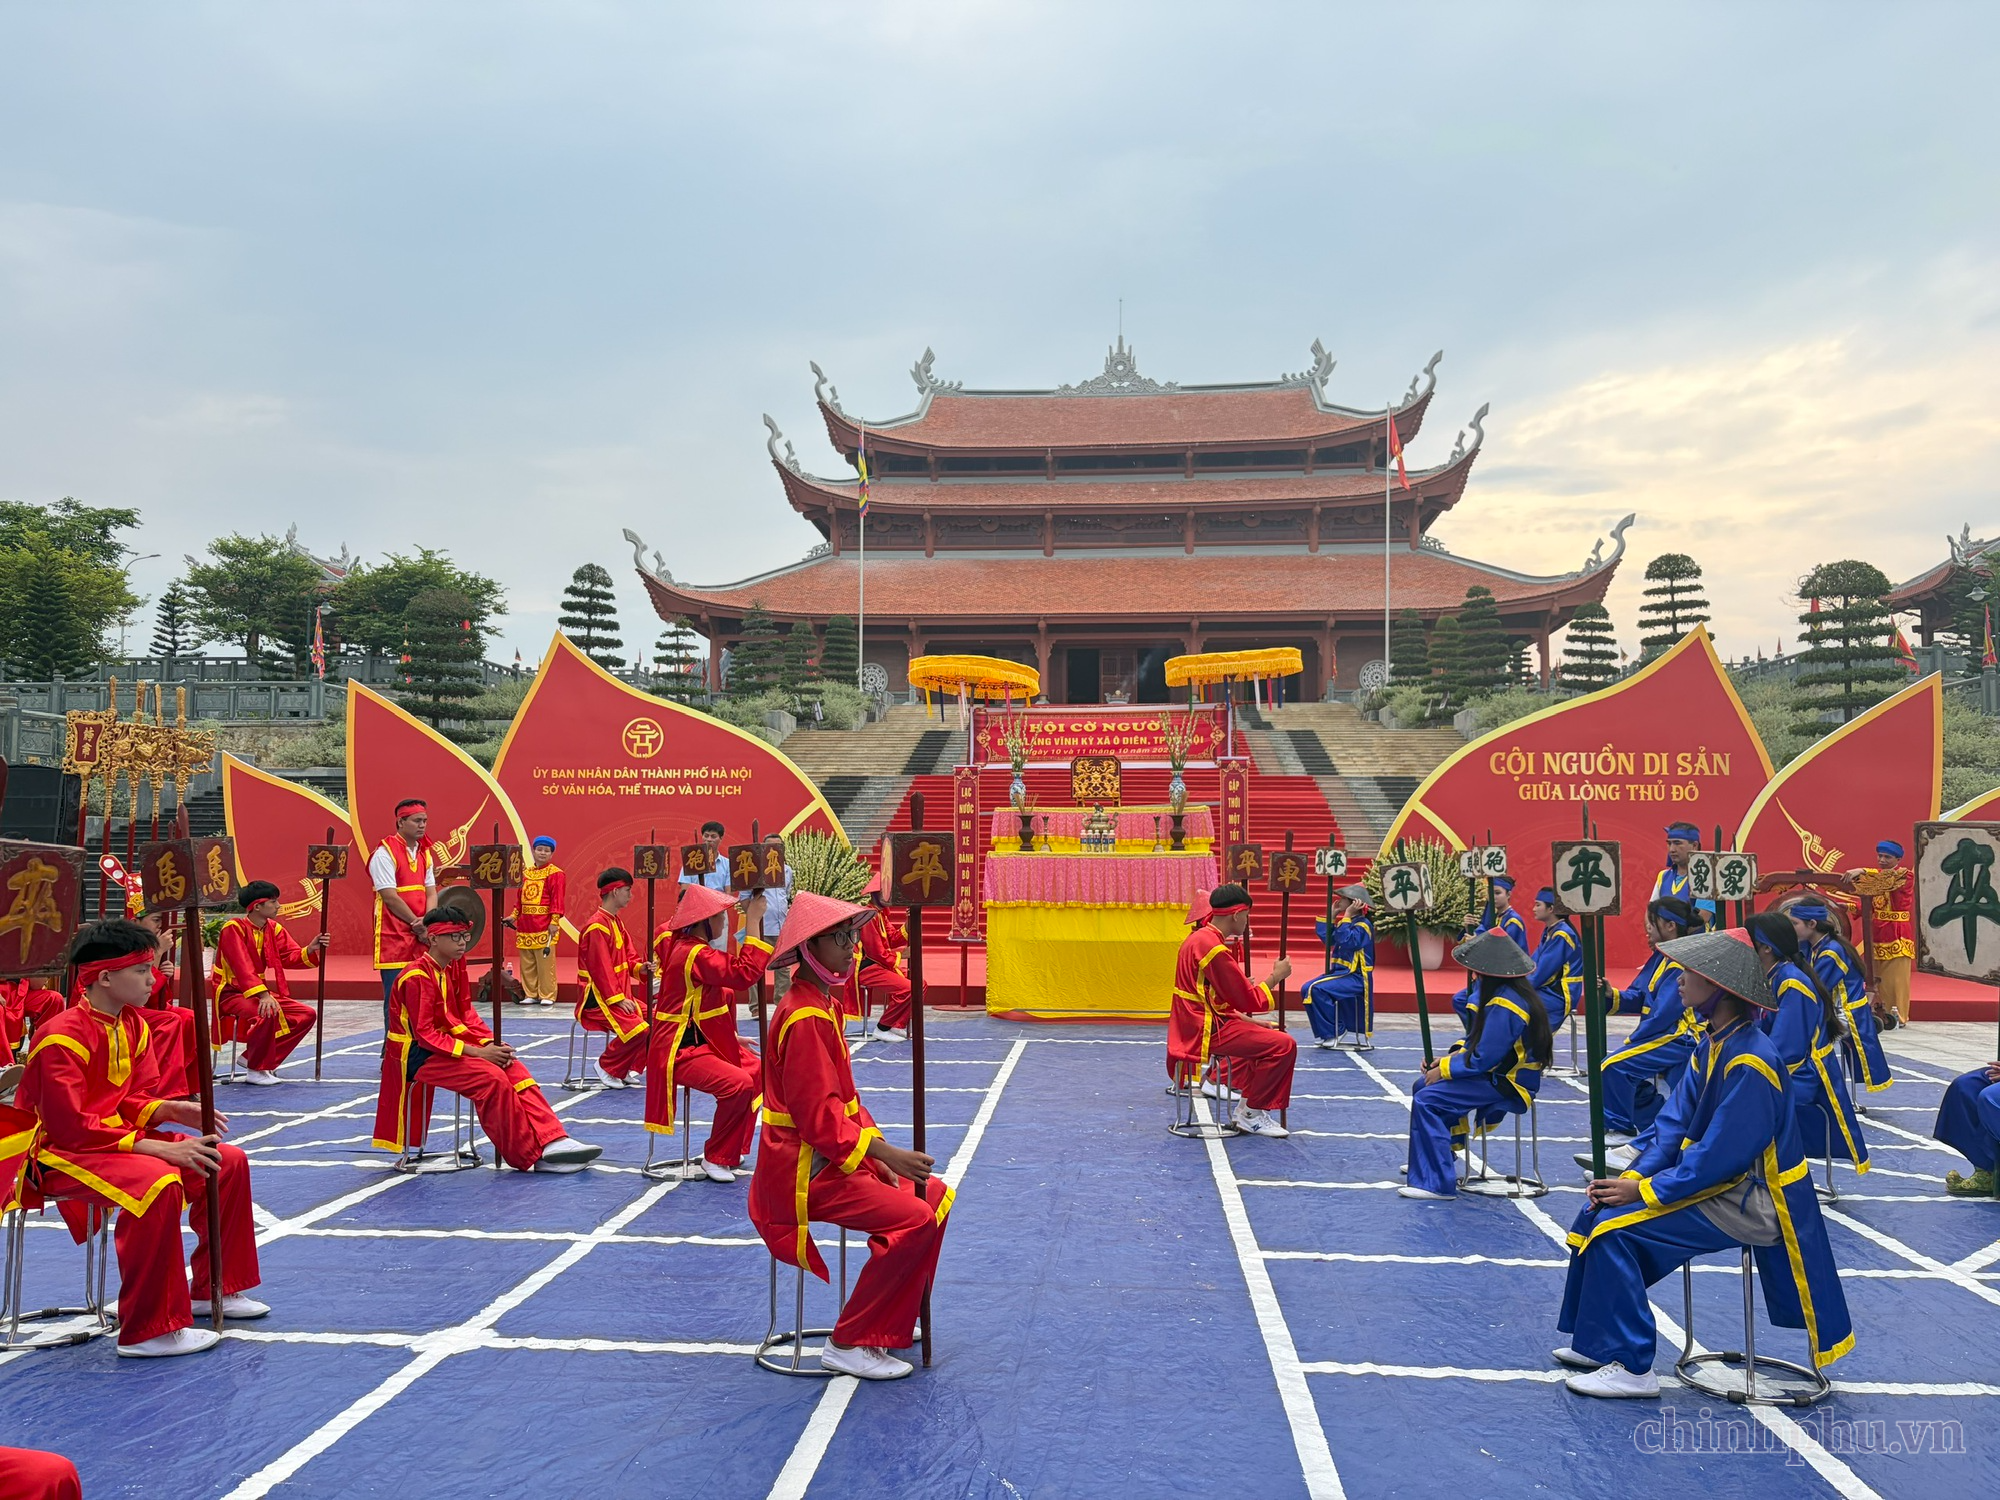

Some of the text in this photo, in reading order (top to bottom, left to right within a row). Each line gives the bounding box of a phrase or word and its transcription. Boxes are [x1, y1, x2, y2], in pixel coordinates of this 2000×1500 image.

[1029, 720, 1168, 734] HỘI CỜ NGƯỜ
[1054, 735, 1079, 746] VĨNH
[1097, 735, 1111, 746] XÃ
[1113, 735, 1120, 745] Ô
[1122, 735, 1151, 746] DIÊN,
[1185, 734, 1204, 746] ỘI
[1089, 747, 1116, 756] tháng
[1489, 743, 1731, 781] CỘI NGUỒN DI SẢN
[533, 765, 752, 782] ỦY BAN NHÂN DÂN THÀNH PHỐ HÀ NỘI
[542, 782, 742, 798] SỞ VĂN HÓA, THỂ THAO VÀ DU LỊCH
[961, 787, 972, 799] LẠC
[1228, 779, 1240, 793] GẶP
[1518, 779, 1699, 801] GIỮA LÒNG THỦ ĐÔ
[959, 801, 975, 814] NƯỚC
[961, 820, 971, 830] HAI
[1228, 812, 1240, 827] MỘT
[962, 836, 970, 846] XE
[1229, 827, 1240, 841] TỐT
[958, 852, 974, 863] ĐÀNH
[203, 844, 230, 896] 馬
[152, 851, 186, 904] 馬
[961, 884, 971, 897] PHÍ
